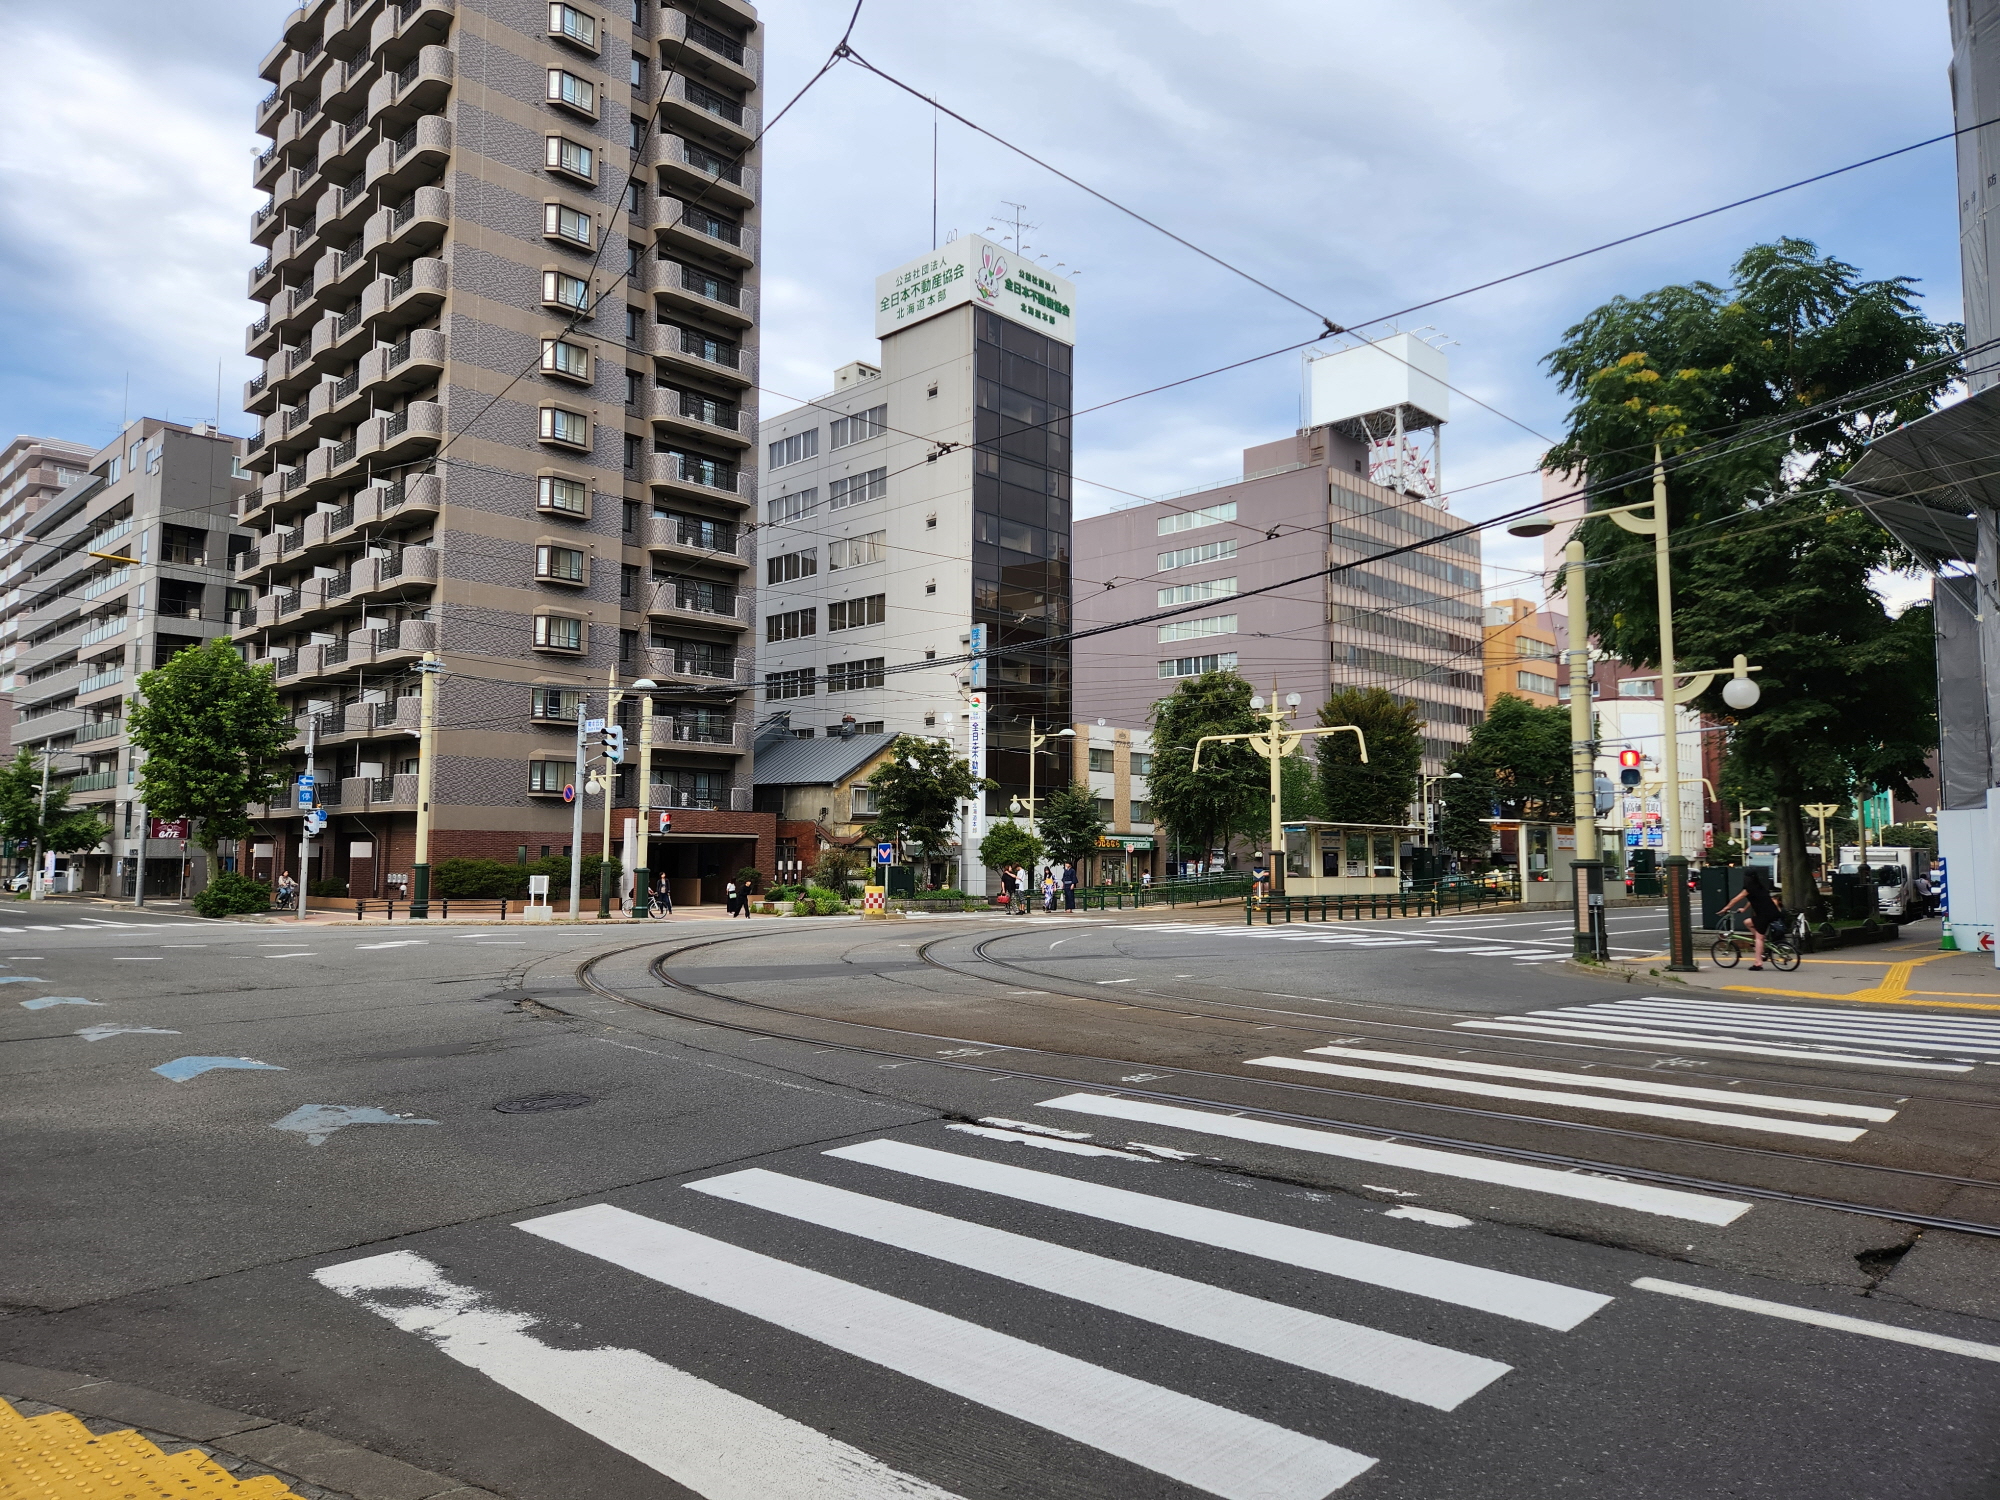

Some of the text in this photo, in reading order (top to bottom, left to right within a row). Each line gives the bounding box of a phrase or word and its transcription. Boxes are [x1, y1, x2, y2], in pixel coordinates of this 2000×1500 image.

[880, 263, 965, 312] 全日本不動産協会
[895, 256, 947, 287] 公益社団法人
[896, 288, 947, 320] 北海道本部
[1004, 278, 1070, 317] 全日本不動産協会
[1627, 835, 1638, 845] 5F
